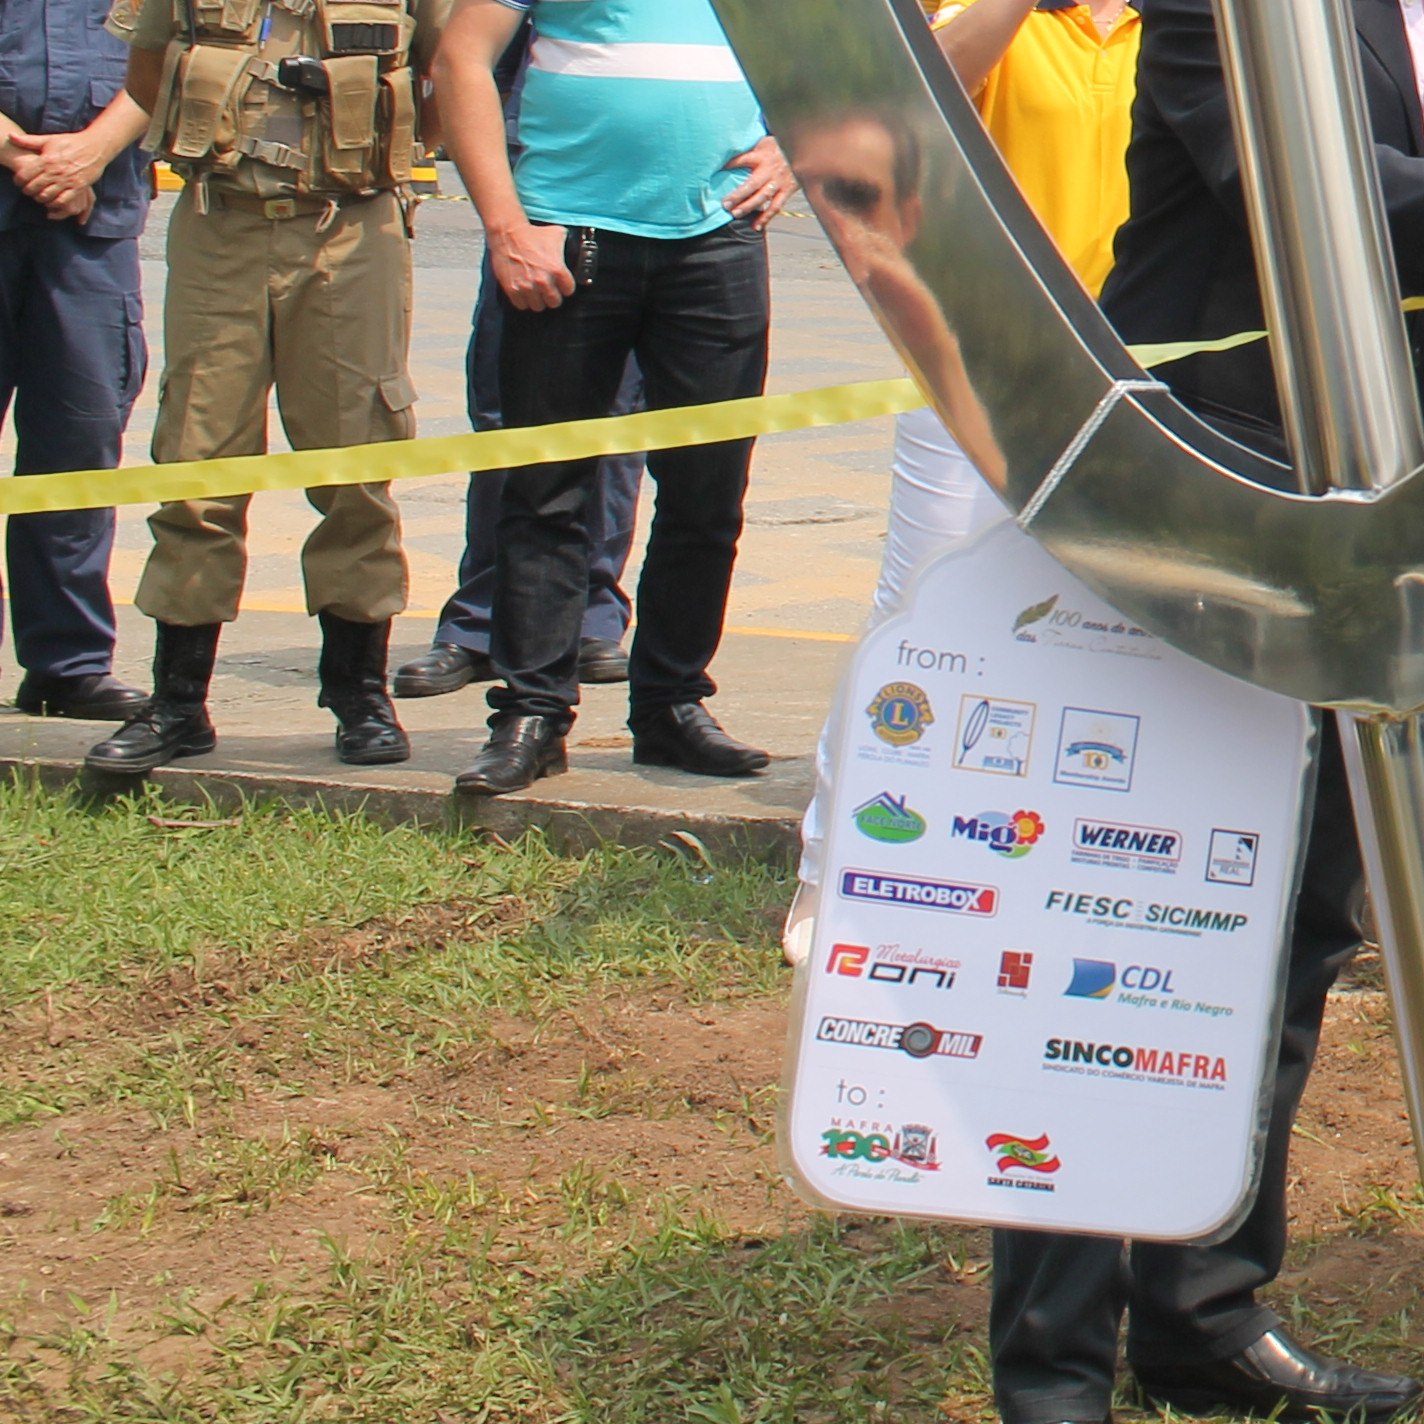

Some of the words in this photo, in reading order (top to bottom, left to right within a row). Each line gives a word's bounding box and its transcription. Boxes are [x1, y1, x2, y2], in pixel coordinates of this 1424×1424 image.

[1049, 609, 1082, 627] 100
[897, 639, 967, 674] from
[882, 683, 923, 702] LIONS
[891, 702, 909, 726] L
[1080, 825, 1176, 856] WERNER
[852, 876, 981, 910] ELETROBOX
[1045, 890, 1133, 919] FIESC
[1145, 903, 1248, 932] SICIMMP
[1121, 965, 1175, 993] CDL
[1117, 992, 1157, 1009] Mafra
[1160, 999, 1168, 1008] e
[1171, 999, 1191, 1012] Rio
[1194, 1002, 1234, 1017] Negro
[1044, 1038, 1227, 1082] SINCOMAFRA
[1042, 1063, 1085, 1075] SINDICATO
[1086, 1068, 1099, 1077] DO
[1186, 1080, 1197, 1088] DE
[1199, 1081, 1226, 1092] MAFRA
[837, 1078, 867, 1106] to
[831, 1117, 894, 1133] MAFRA
[987, 1176, 1014, 1187] SANTA
[1016, 1179, 1055, 1192] CATARINA
